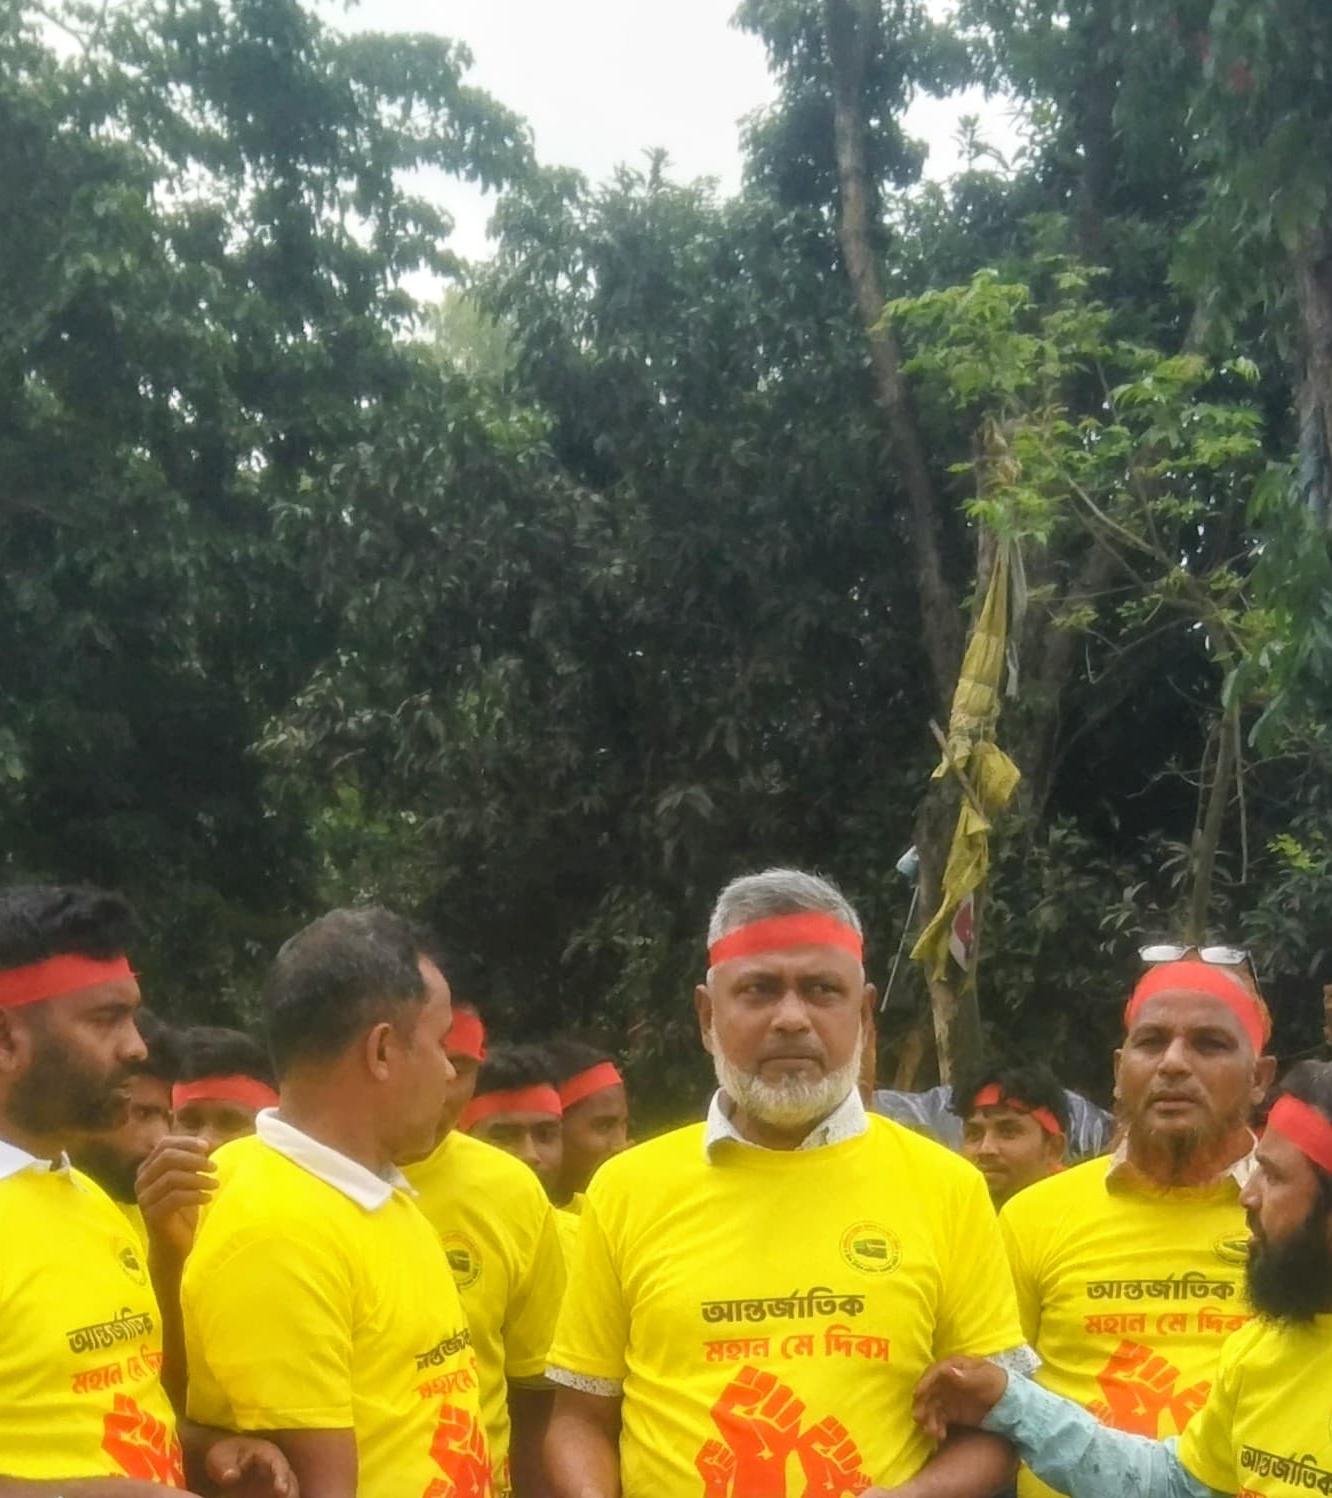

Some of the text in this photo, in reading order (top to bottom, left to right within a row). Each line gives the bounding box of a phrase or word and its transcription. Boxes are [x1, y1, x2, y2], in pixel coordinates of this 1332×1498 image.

[1086, 1271, 1235, 1301] আন্তর্জাতিক
[701, 1286, 865, 1323] আন্তর্জাতিক
[1085, 1313, 1146, 1334] মহান
[1156, 1313, 1187, 1335] মে
[703, 1324, 890, 1363] মহান মে দিবস
